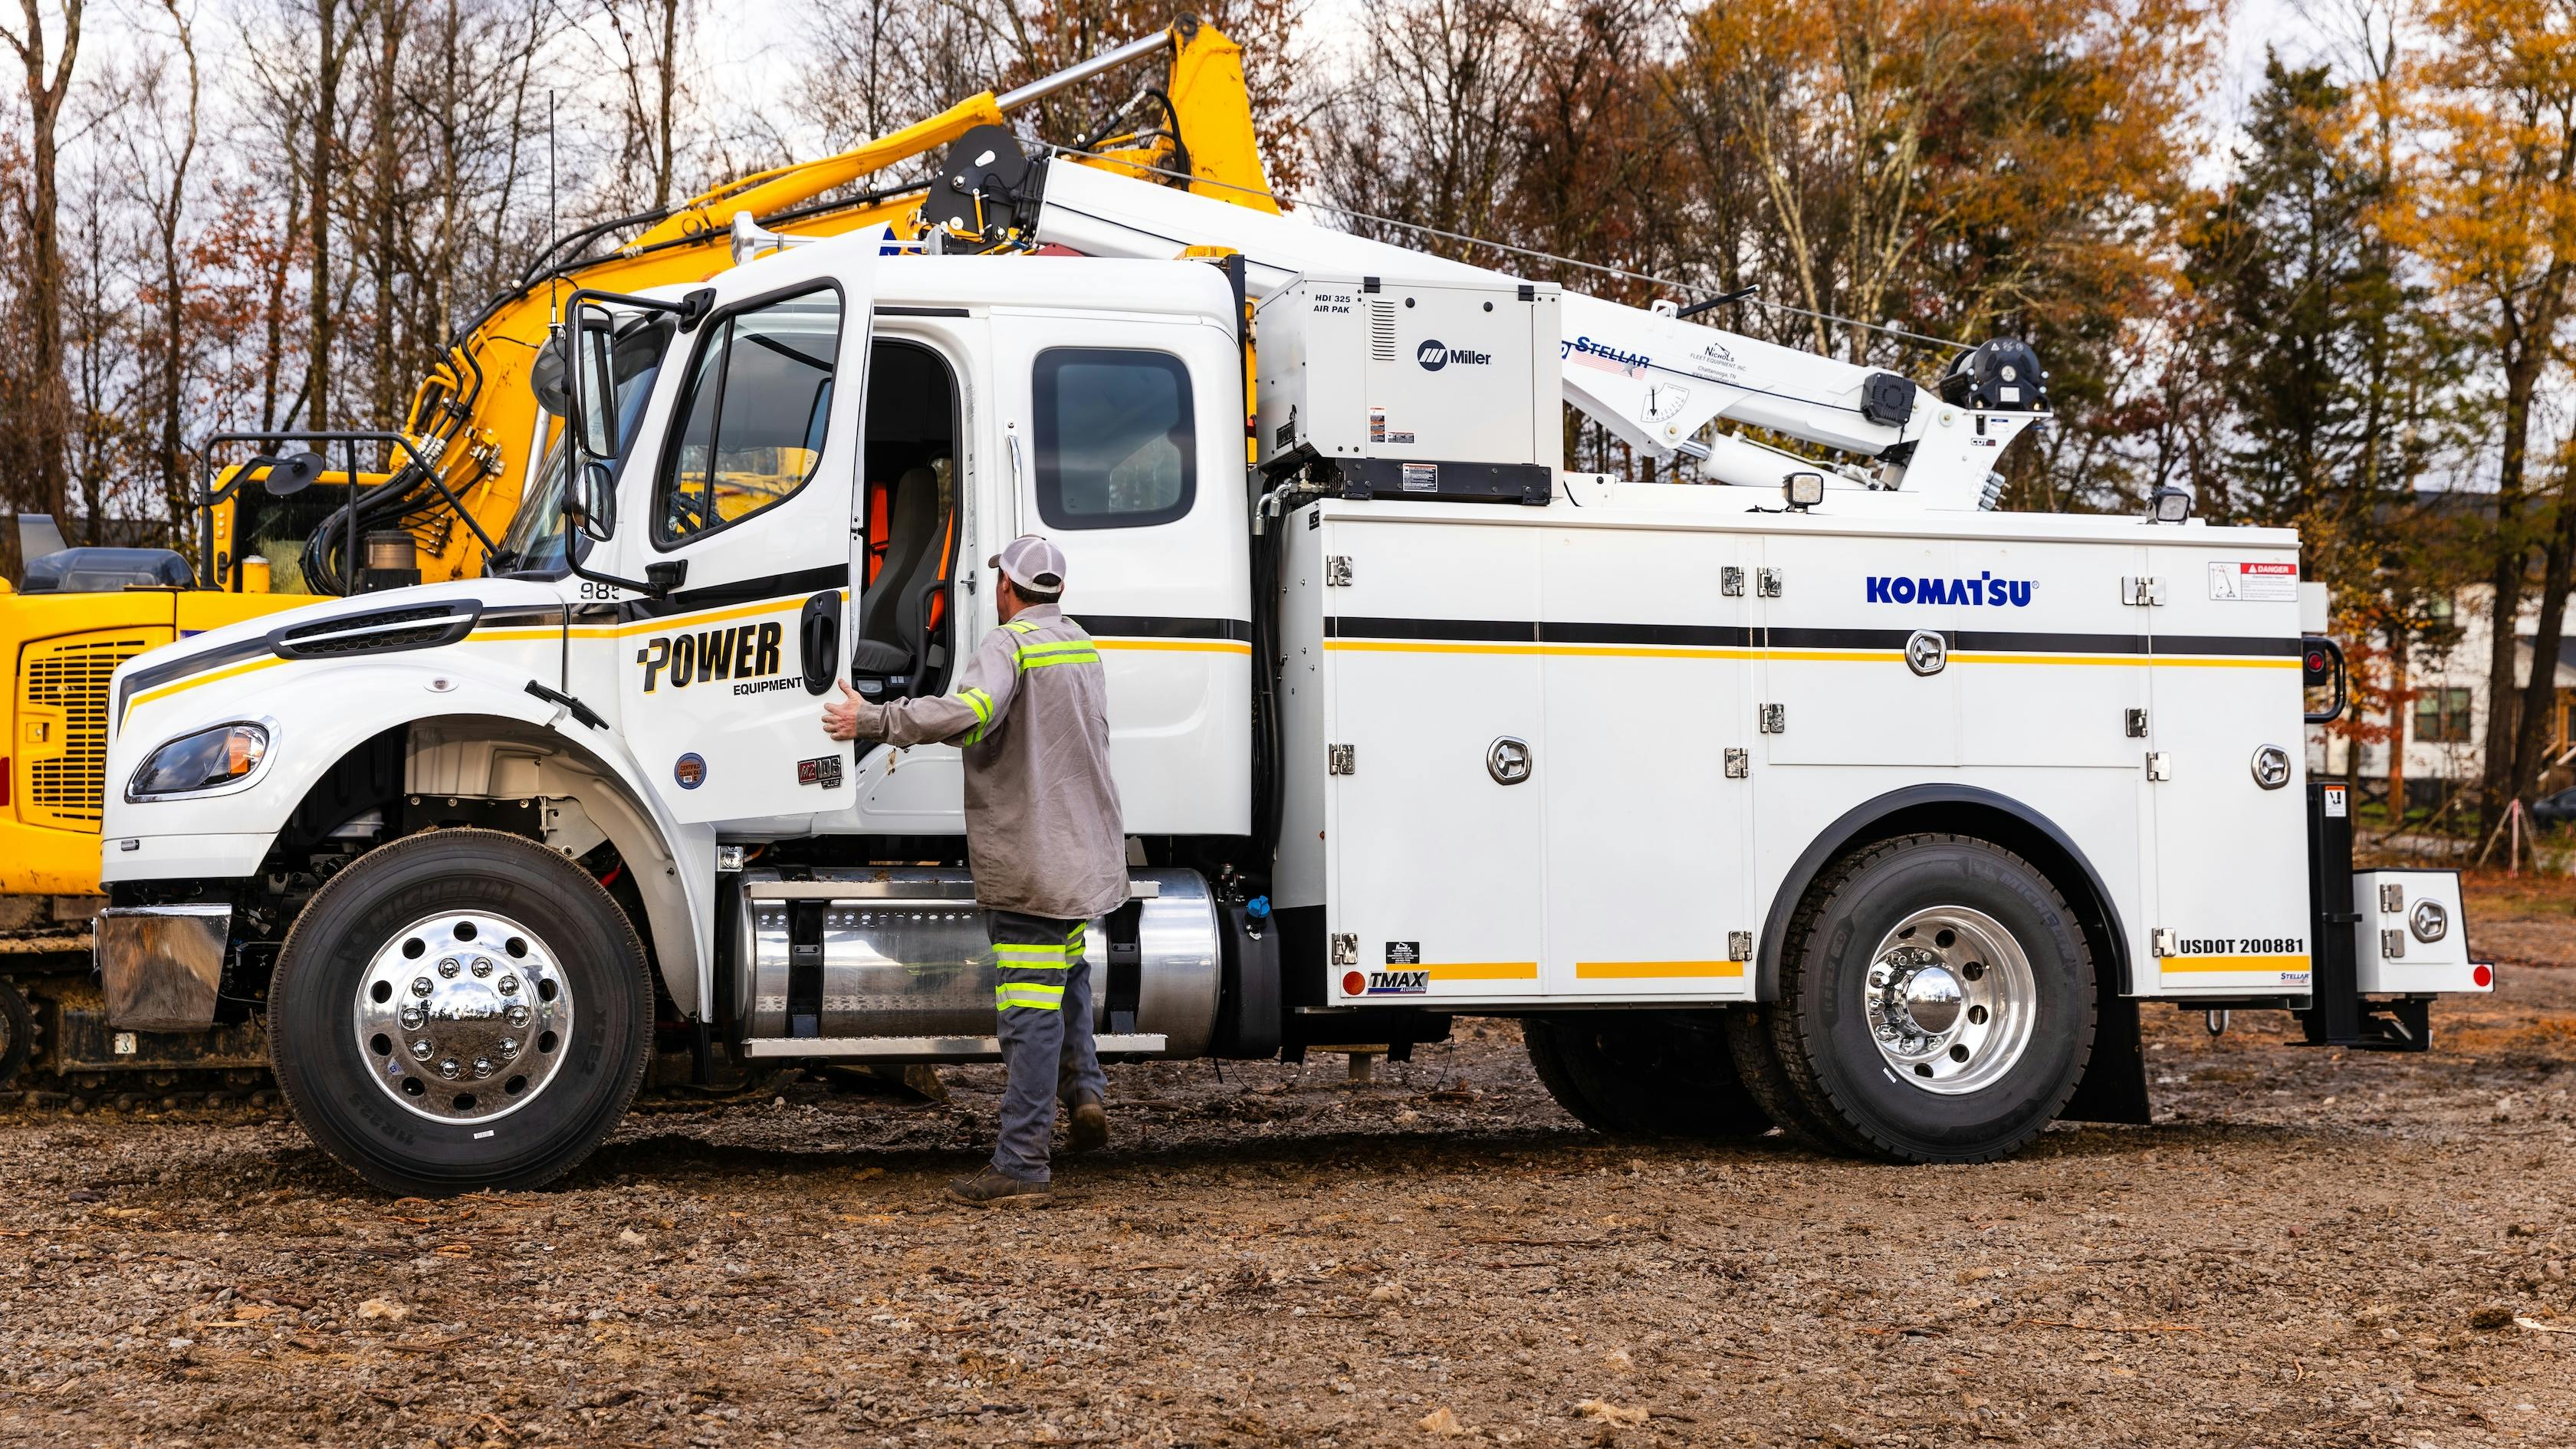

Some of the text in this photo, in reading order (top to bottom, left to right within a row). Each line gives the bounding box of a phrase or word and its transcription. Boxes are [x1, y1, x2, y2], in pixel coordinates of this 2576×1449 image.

[1450, 350, 1491, 365] Miller
[2257, 565, 2289, 573] DANGER
[1866, 570, 2032, 607] KOMATSU
[636, 621, 784, 695] POWER
[733, 676, 803, 696] EQUIPMENT
[2180, 938, 2303, 954] USDOT 200881
[1371, 972, 1426, 987] TMAX
